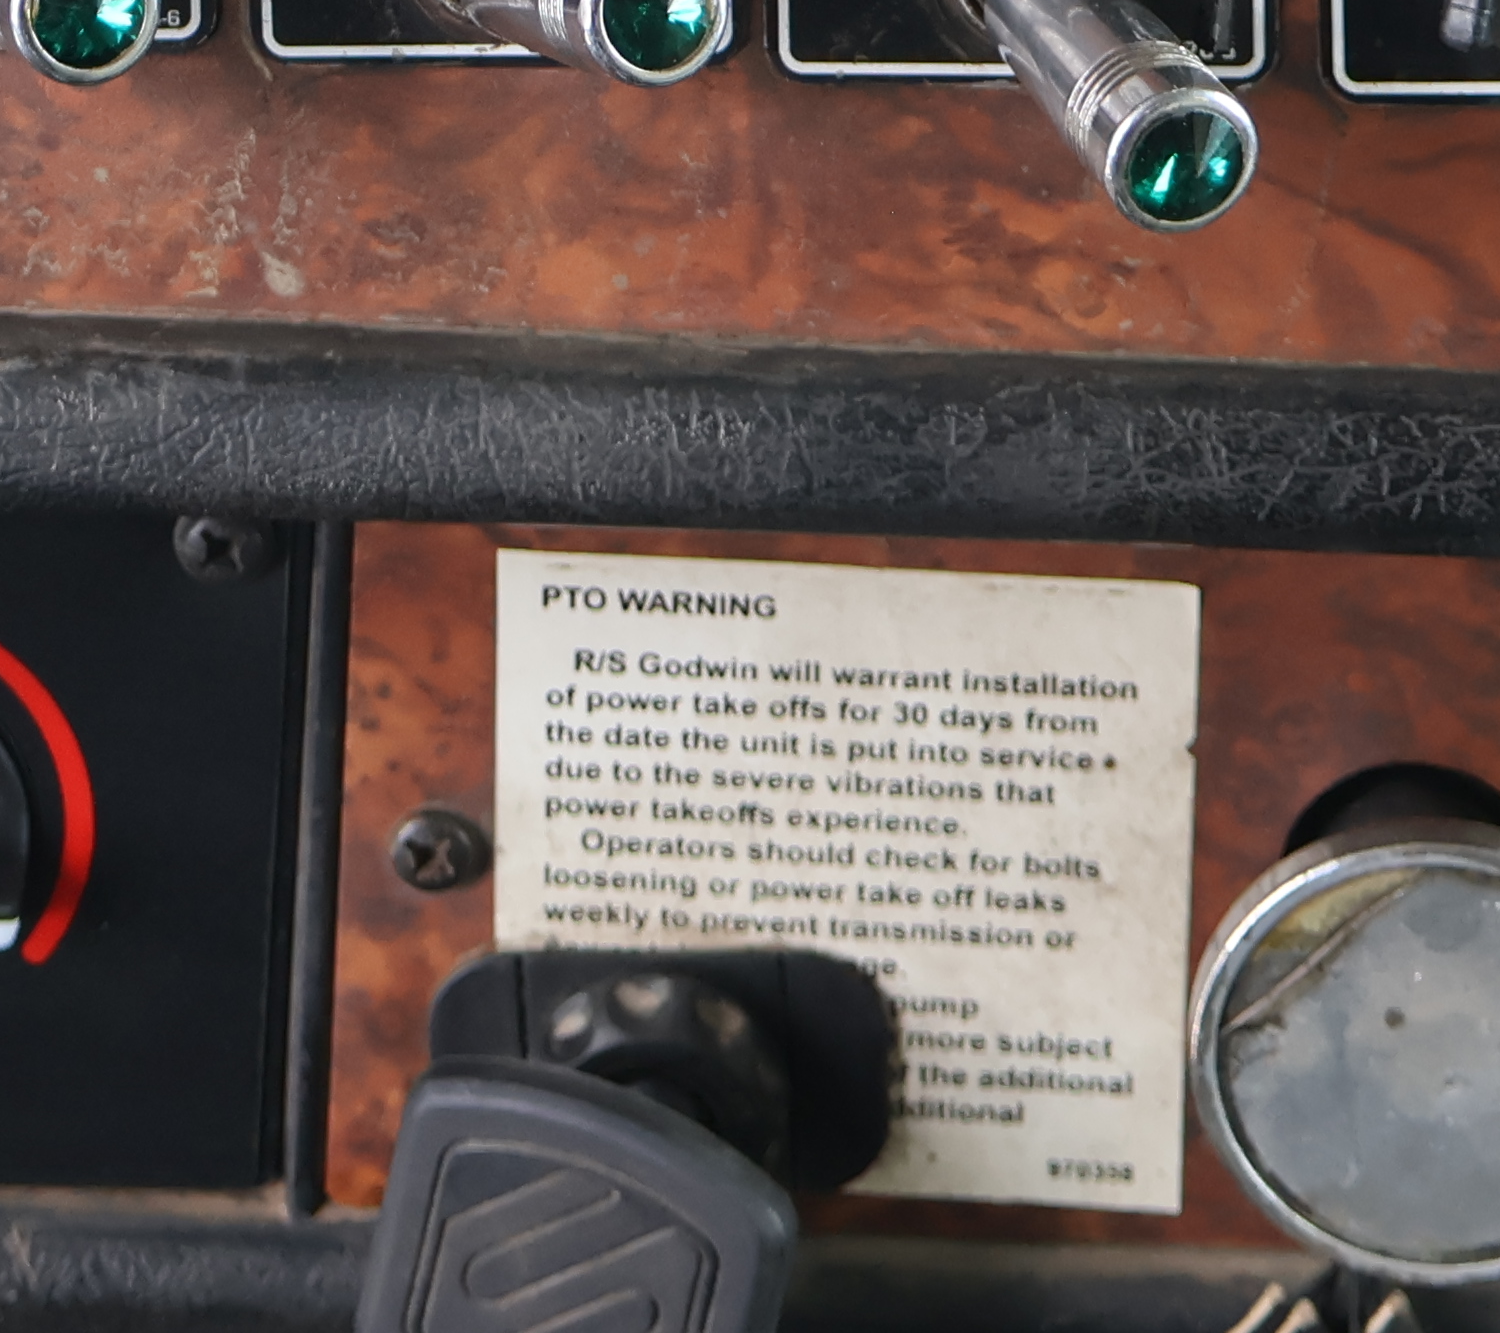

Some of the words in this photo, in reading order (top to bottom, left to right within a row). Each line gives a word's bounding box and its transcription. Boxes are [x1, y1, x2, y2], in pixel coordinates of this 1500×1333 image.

[541, 584, 607, 611] PTO
[618, 587, 777, 619] WARNING
[574, 647, 628, 674] R/S
[639, 651, 758, 680] Godwin
[769, 658, 821, 683] will
[831, 667, 952, 691] warrant
[962, 668, 1139, 700] installation
[545, 683, 577, 707] of
[586, 689, 682, 714] power
[694, 691, 758, 717] take
[769, 694, 827, 720] offs
[839, 698, 882, 723] for
[894, 700, 928, 725] 30
[939, 704, 1014, 734] days
[1025, 708, 1099, 734] from
[545, 720, 593, 745] the
[604, 723, 671, 748] date
[681, 726, 729, 751] the
[741, 730, 800, 756] unit
[810, 732, 837, 757] is
[847, 738, 898, 763] put
[909, 737, 969, 764] into
[980, 745, 1094, 770] service
[545, 755, 601, 780] due
[613, 758, 643, 783] to
[653, 761, 701, 786] the
[712, 770, 815, 792] severe
[827, 770, 984, 800] vibrations
[996, 779, 1056, 804] that
[545, 795, 639, 819] power
[651, 797, 775, 827] takeoffs
[580, 827, 736, 859] Operators
[749, 838, 855, 865] should
[865, 844, 958, 871] check
[969, 848, 1013, 873] for
[1024, 851, 1101, 878] bolts
[544, 862, 698, 898] loosening
[709, 876, 740, 896] or
[751, 878, 844, 902] power
[857, 881, 922, 906] take
[933, 883, 976, 907] off
[986, 887, 1067, 913] leaks
[544, 903, 648, 930] weekly
[660, 905, 690, 928] to
[700, 909, 818, 937] prevent
[829, 918, 1034, 947] transmission
[1045, 929, 1077, 949] or
[905, 1029, 987, 1052] more
[996, 1031, 1114, 1062] subject
[978, 1065, 1135, 1096] additional
